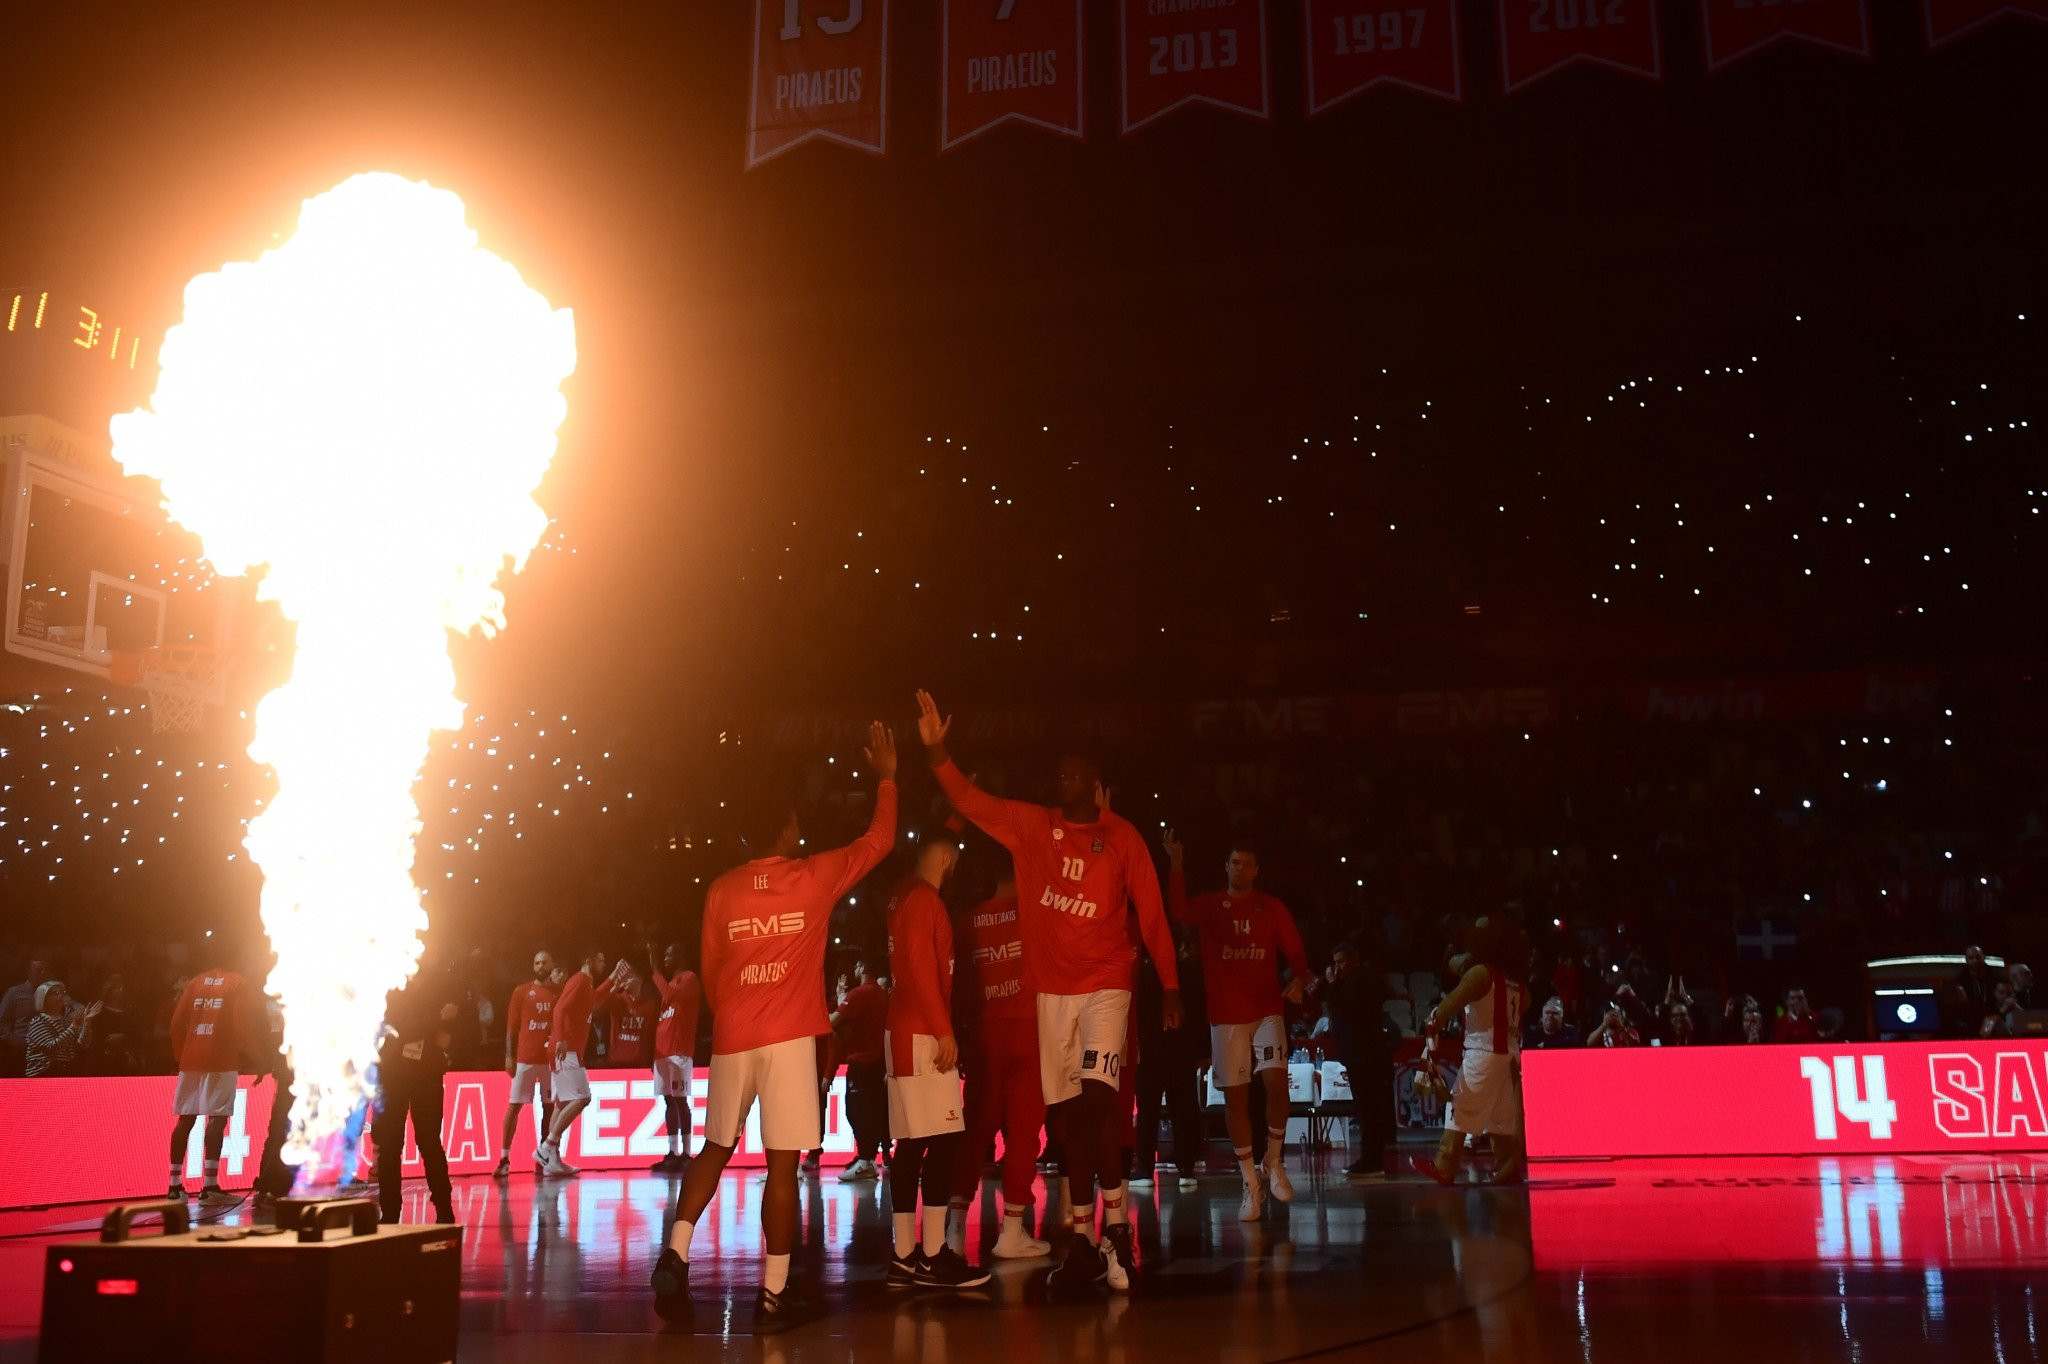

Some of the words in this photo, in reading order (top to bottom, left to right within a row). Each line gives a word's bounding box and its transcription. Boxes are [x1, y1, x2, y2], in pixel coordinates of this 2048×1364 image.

[1333, 8, 1427, 55] 1997
[1148, 27, 1239, 76] 2013
[967, 49, 1057, 94] PIRAEUS
[775, 67, 862, 110] PIRAEUS
[753, 873, 768, 890] LEE
[1062, 856, 1084, 880] 10
[1040, 885, 1097, 918] bwin
[727, 911, 805, 943] FMS
[1233, 919, 1250, 935] 14
[1222, 942, 1266, 960] bwin
[740, 960, 788, 986] PIRAEUS
[1102, 1051, 1120, 1078] 10
[1800, 1055, 1897, 1140] 14
[1928, 1052, 2048, 1138] SA
